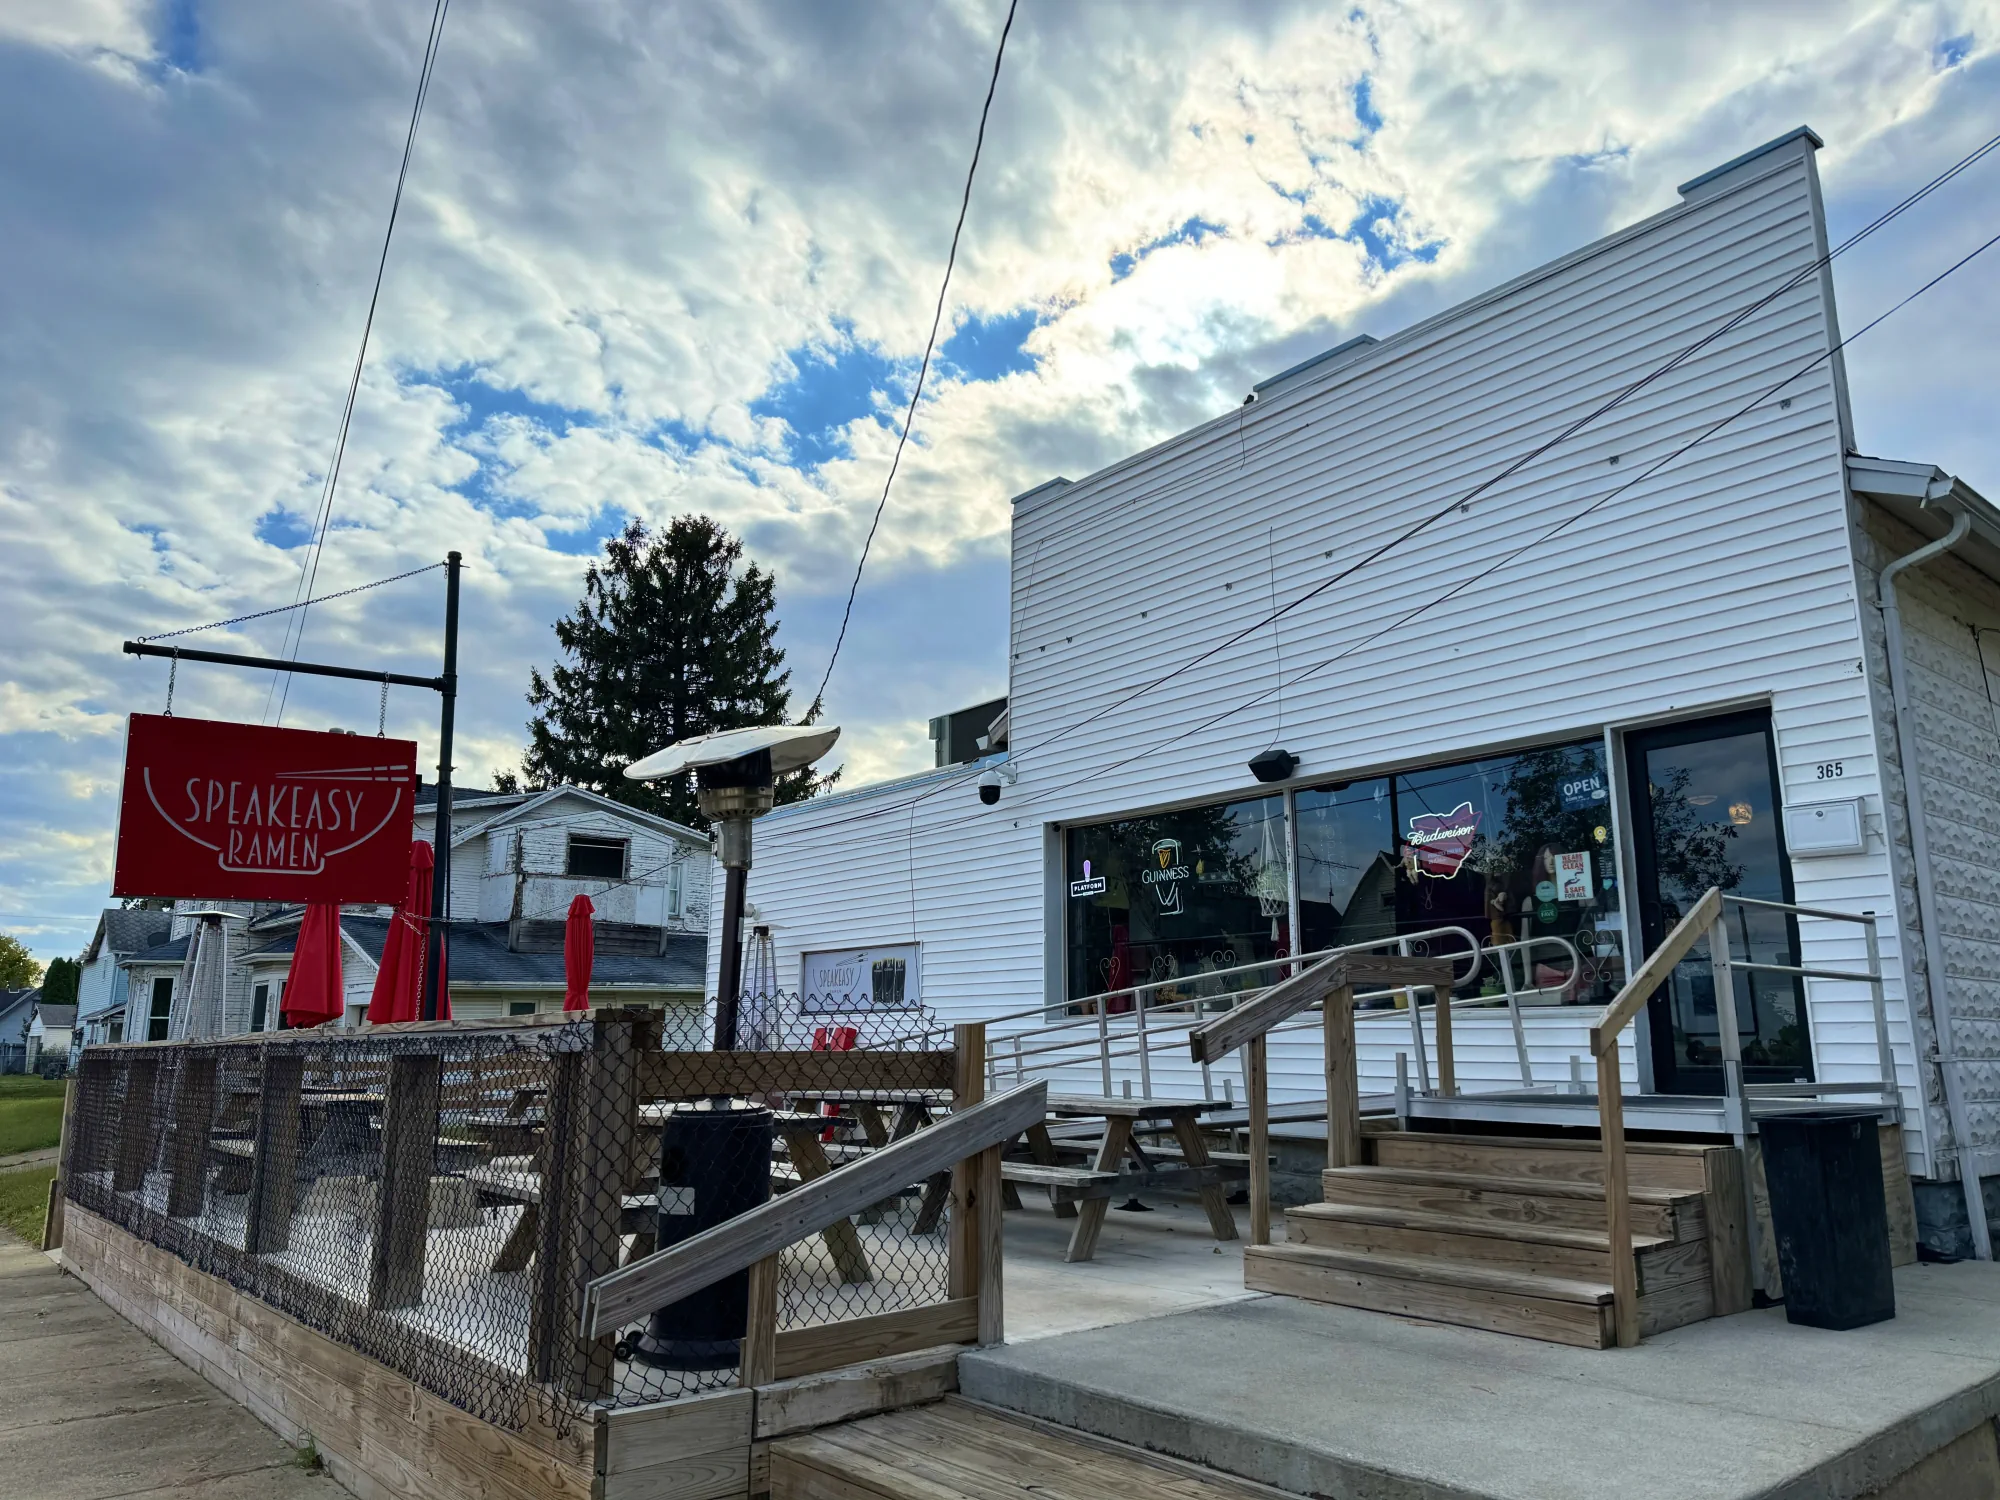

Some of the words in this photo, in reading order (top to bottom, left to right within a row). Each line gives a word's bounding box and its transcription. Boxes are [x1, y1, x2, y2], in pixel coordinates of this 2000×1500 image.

[1817, 762, 1843, 779] 365
[1563, 776, 1600, 796] OPEN
[185, 777, 364, 832] SPEAKEASY
[1407, 825, 1475, 846] Budweiser
[227, 828, 319, 868] RAMEN
[1142, 866, 1190, 884] GUINNESS
[1562, 862, 1584, 870] CLEAN
[1074, 882, 1102, 892] PLATFORM
[820, 967, 855, 988] SPEAKEASY
